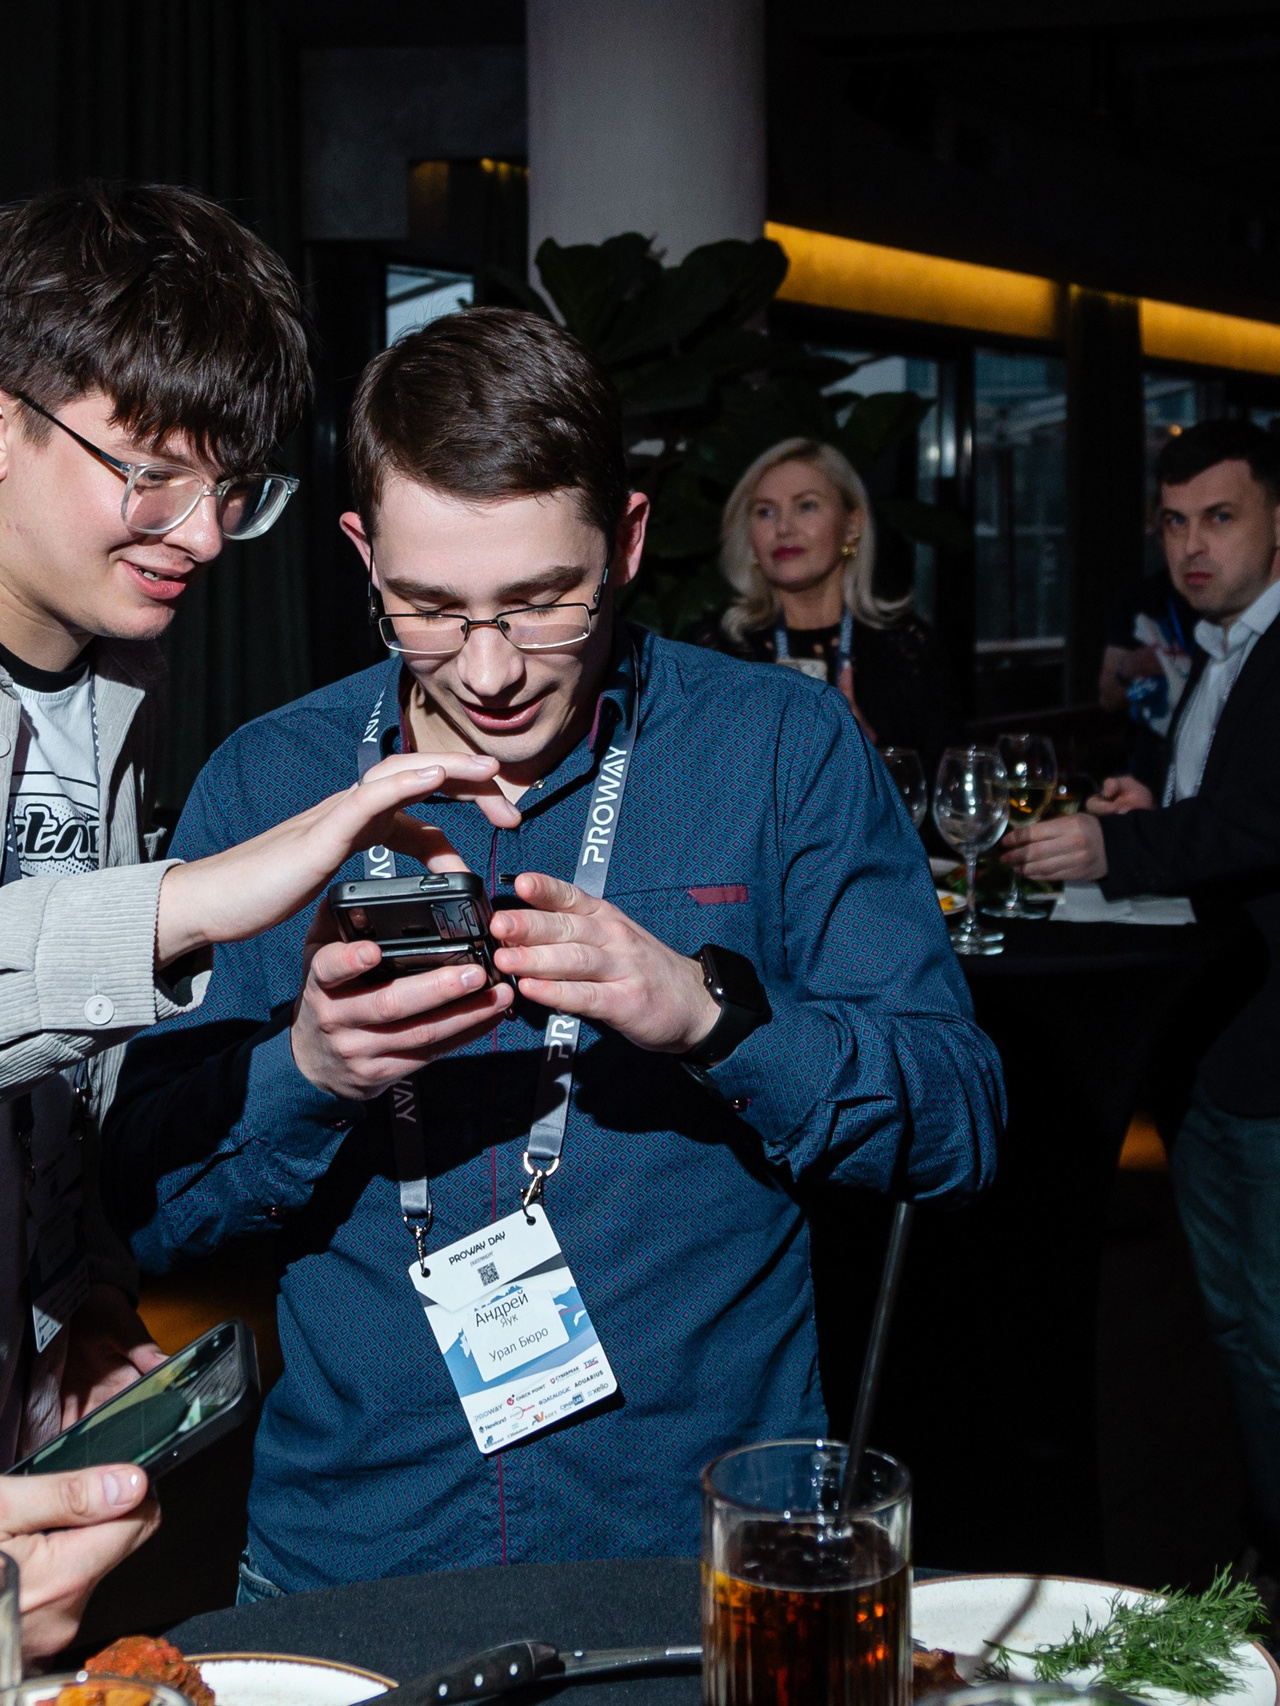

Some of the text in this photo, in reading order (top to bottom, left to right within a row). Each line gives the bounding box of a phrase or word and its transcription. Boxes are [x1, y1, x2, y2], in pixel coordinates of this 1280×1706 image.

[582, 746, 628, 867] PROWAY
[448, 1241, 486, 1265] PROWAY
[488, 1231, 506, 1247] DAY
[474, 1290, 529, 1327] Андрей
[489, 1327, 549, 1363] Урал Бюро
[515, 1384, 546, 1402] CHECK POINT
[592, 1382, 610, 1396] xello
[474, 1403, 504, 1422] PROWAY
